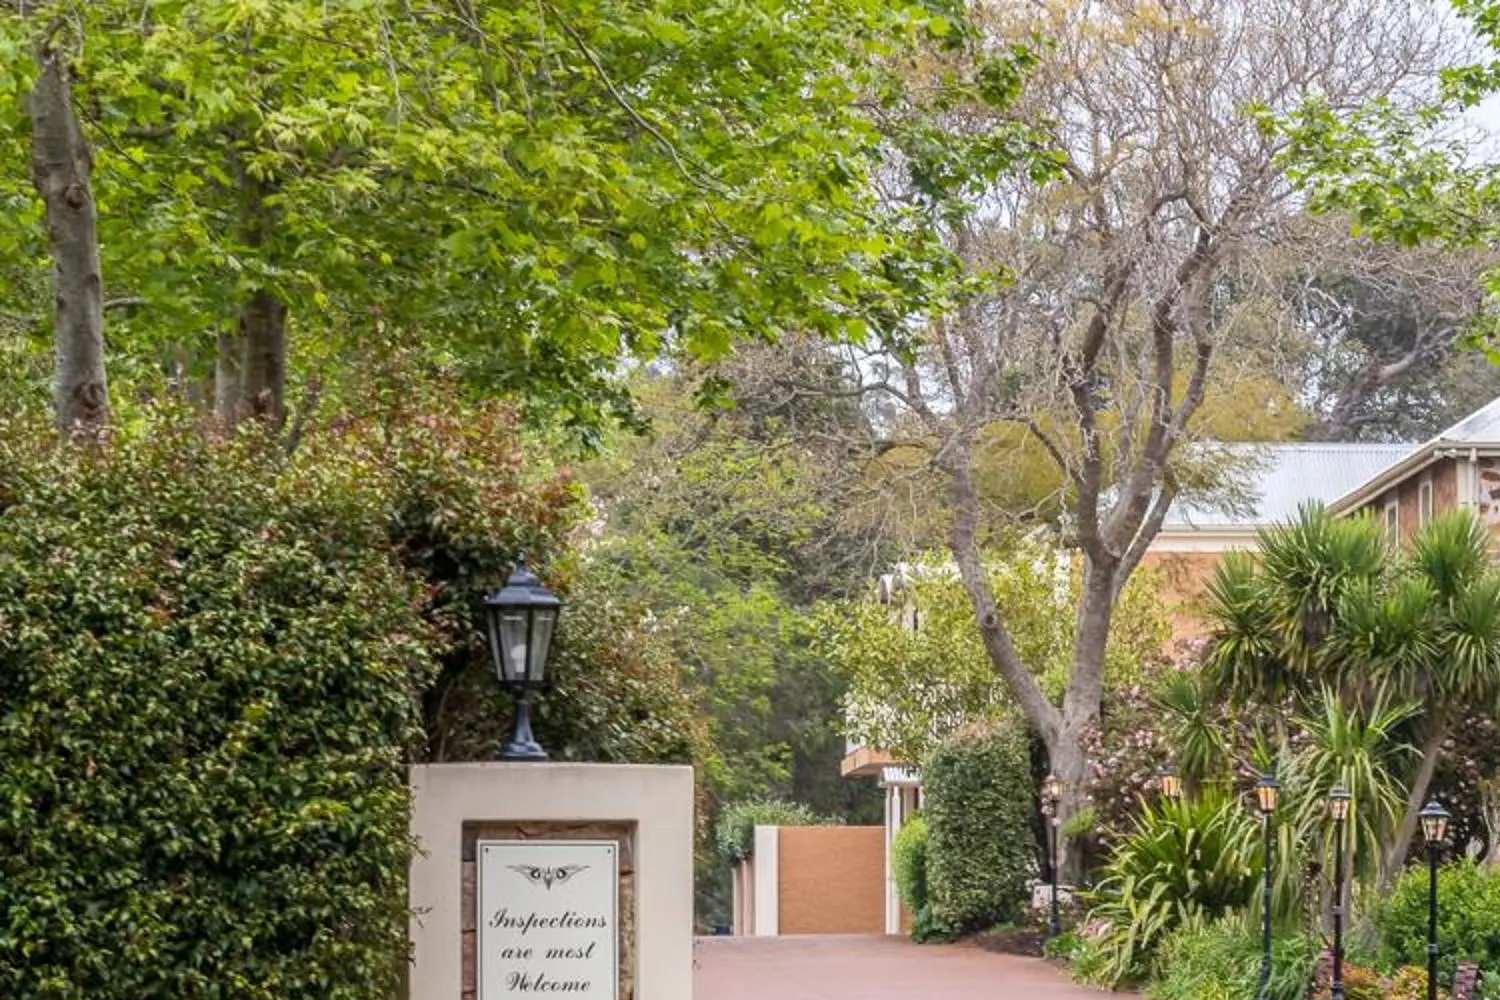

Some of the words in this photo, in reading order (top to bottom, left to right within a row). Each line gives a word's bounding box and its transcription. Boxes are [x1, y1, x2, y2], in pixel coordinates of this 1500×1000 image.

[488, 906, 607, 935] Inspections
[501, 945, 533, 960] are
[545, 941, 596, 960] most
[508, 970, 591, 993] Welcome
